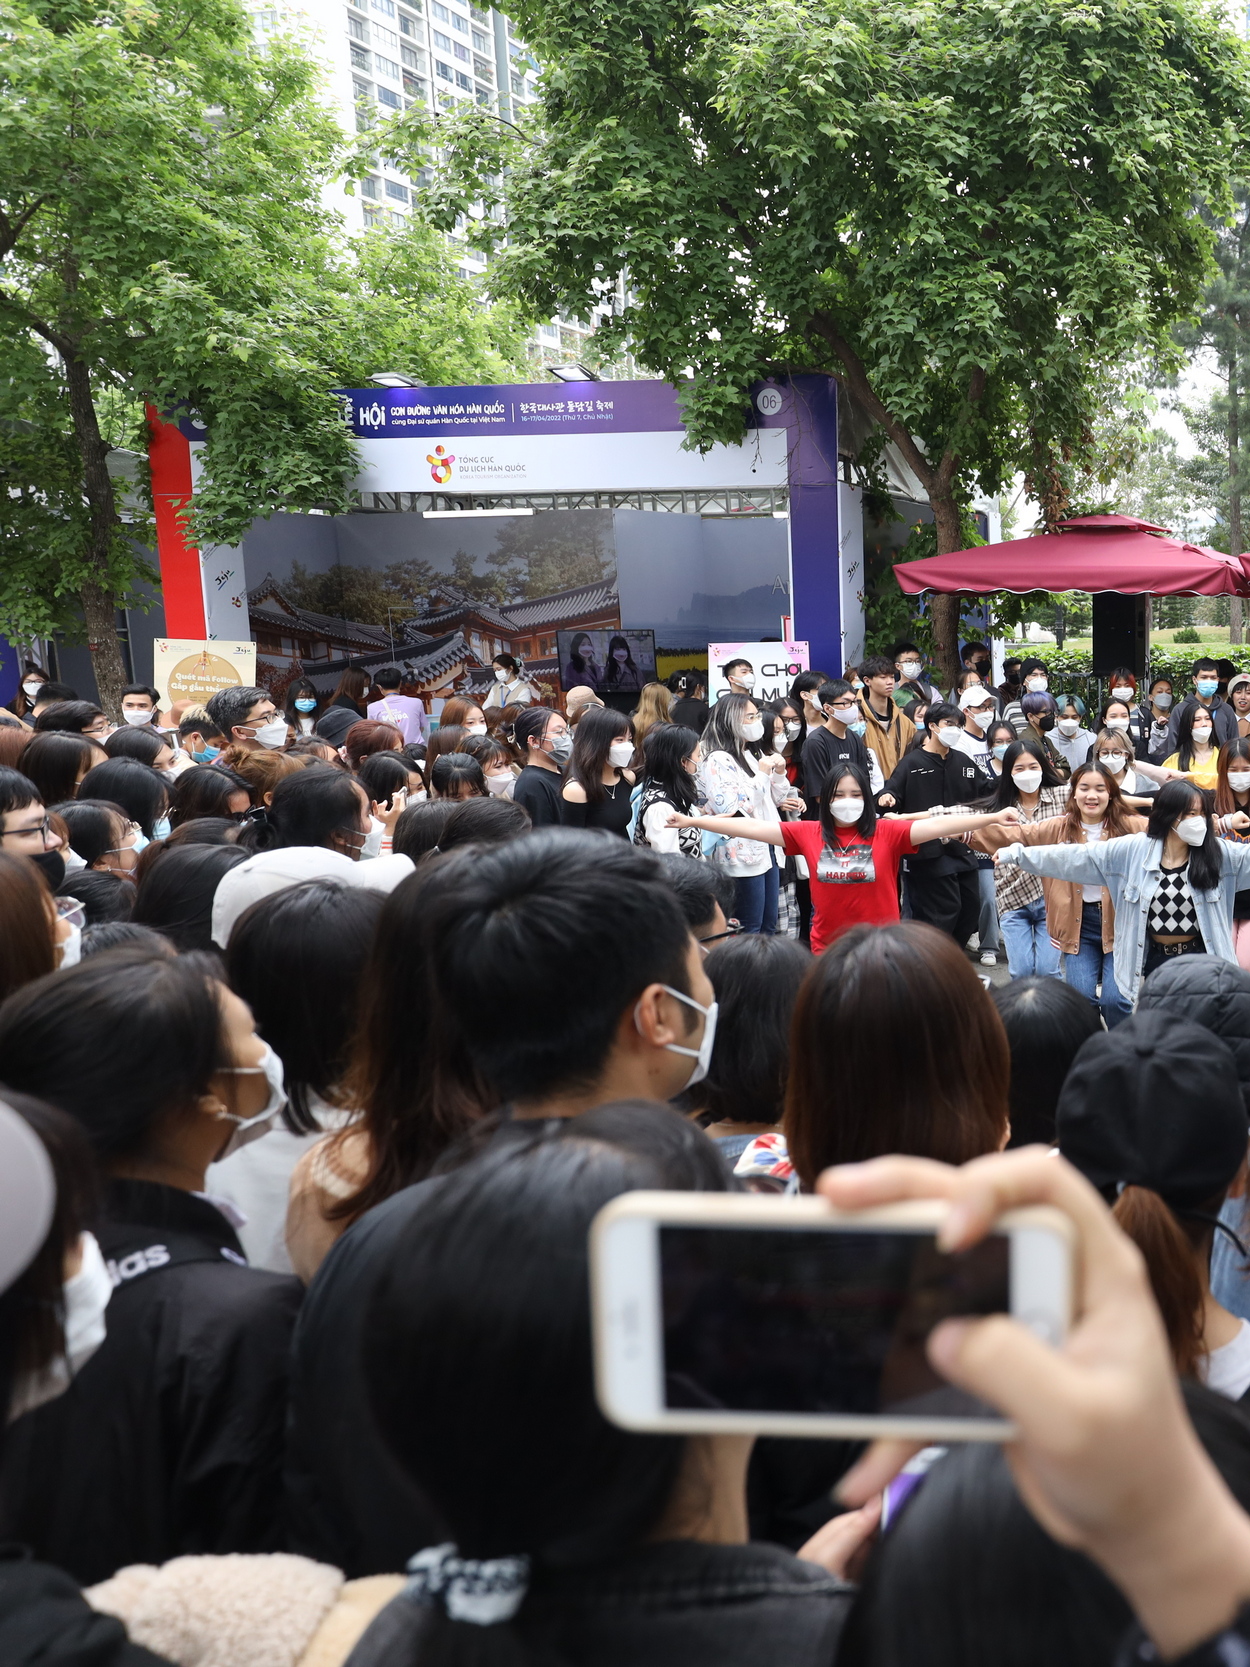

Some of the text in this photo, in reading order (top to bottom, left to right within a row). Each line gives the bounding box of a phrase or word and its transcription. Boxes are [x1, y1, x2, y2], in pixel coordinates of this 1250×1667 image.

[519, 400, 614, 414] 한국대사관 돌담길 축제
[762, 395, 777, 409] 06
[391, 407, 405, 416] CON
[433, 404, 447, 415] VĂN
[450, 403, 464, 415] HÓA
[467, 403, 481, 414] HÀN
[484, 400, 505, 414] QUỐC
[454, 416, 469, 424] Quốc
[470, 416, 478, 424] tại
[459, 465, 469, 473] DU
[487, 464, 503, 472] HÀN
[175, 672, 196, 681] Quét
[212, 675, 239, 684] Follow
[841, 860, 851, 868] IT
[825, 871, 867, 880] HAPPEN
